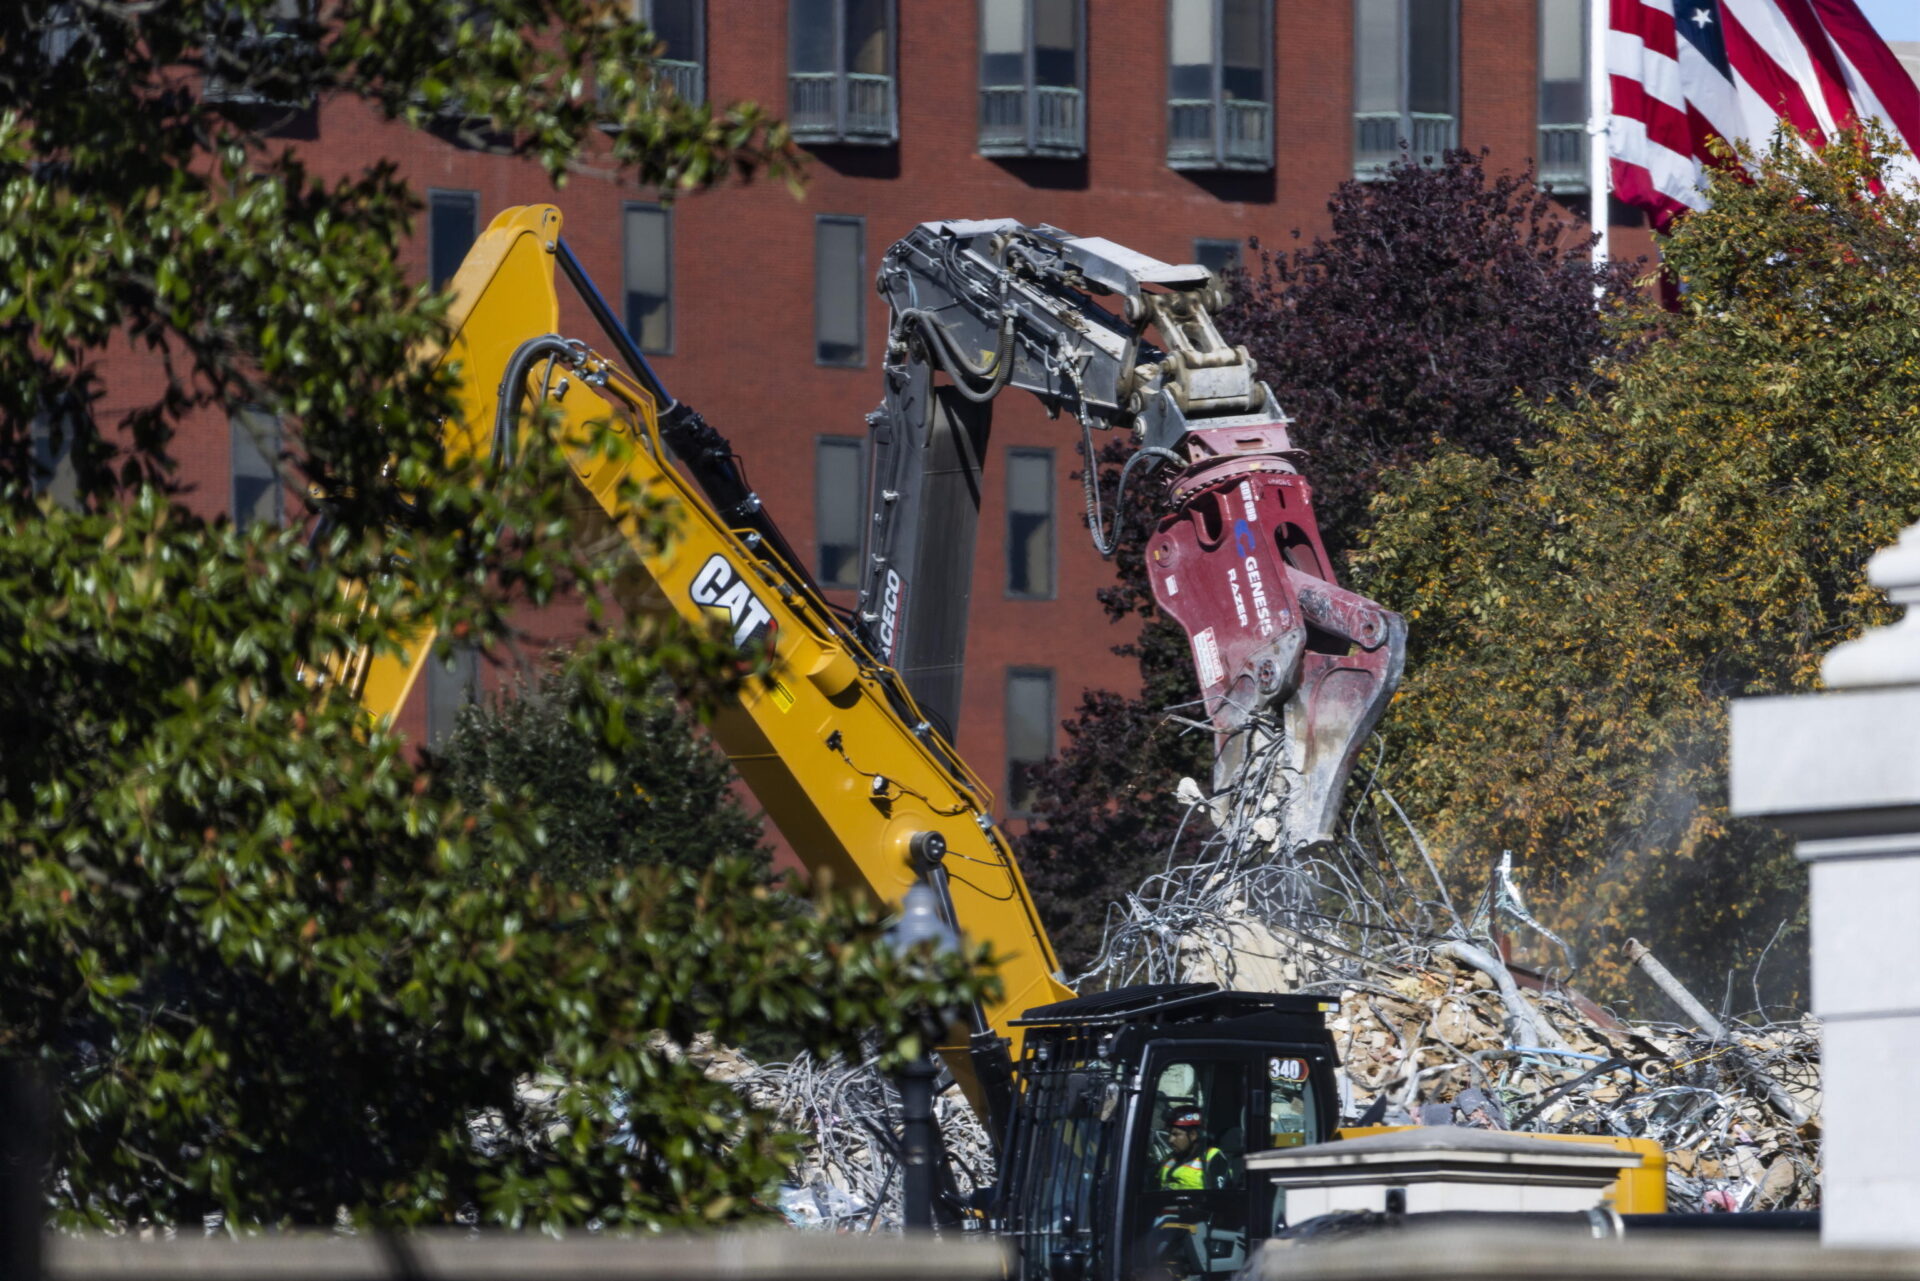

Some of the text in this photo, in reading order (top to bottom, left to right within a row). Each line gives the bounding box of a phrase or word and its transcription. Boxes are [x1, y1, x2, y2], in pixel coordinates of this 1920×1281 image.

[691, 554, 772, 650] CAT
[1227, 568, 1248, 627] RAZER
[1245, 556, 1273, 636] GENESIS
[1269, 1058, 1300, 1079] 340
